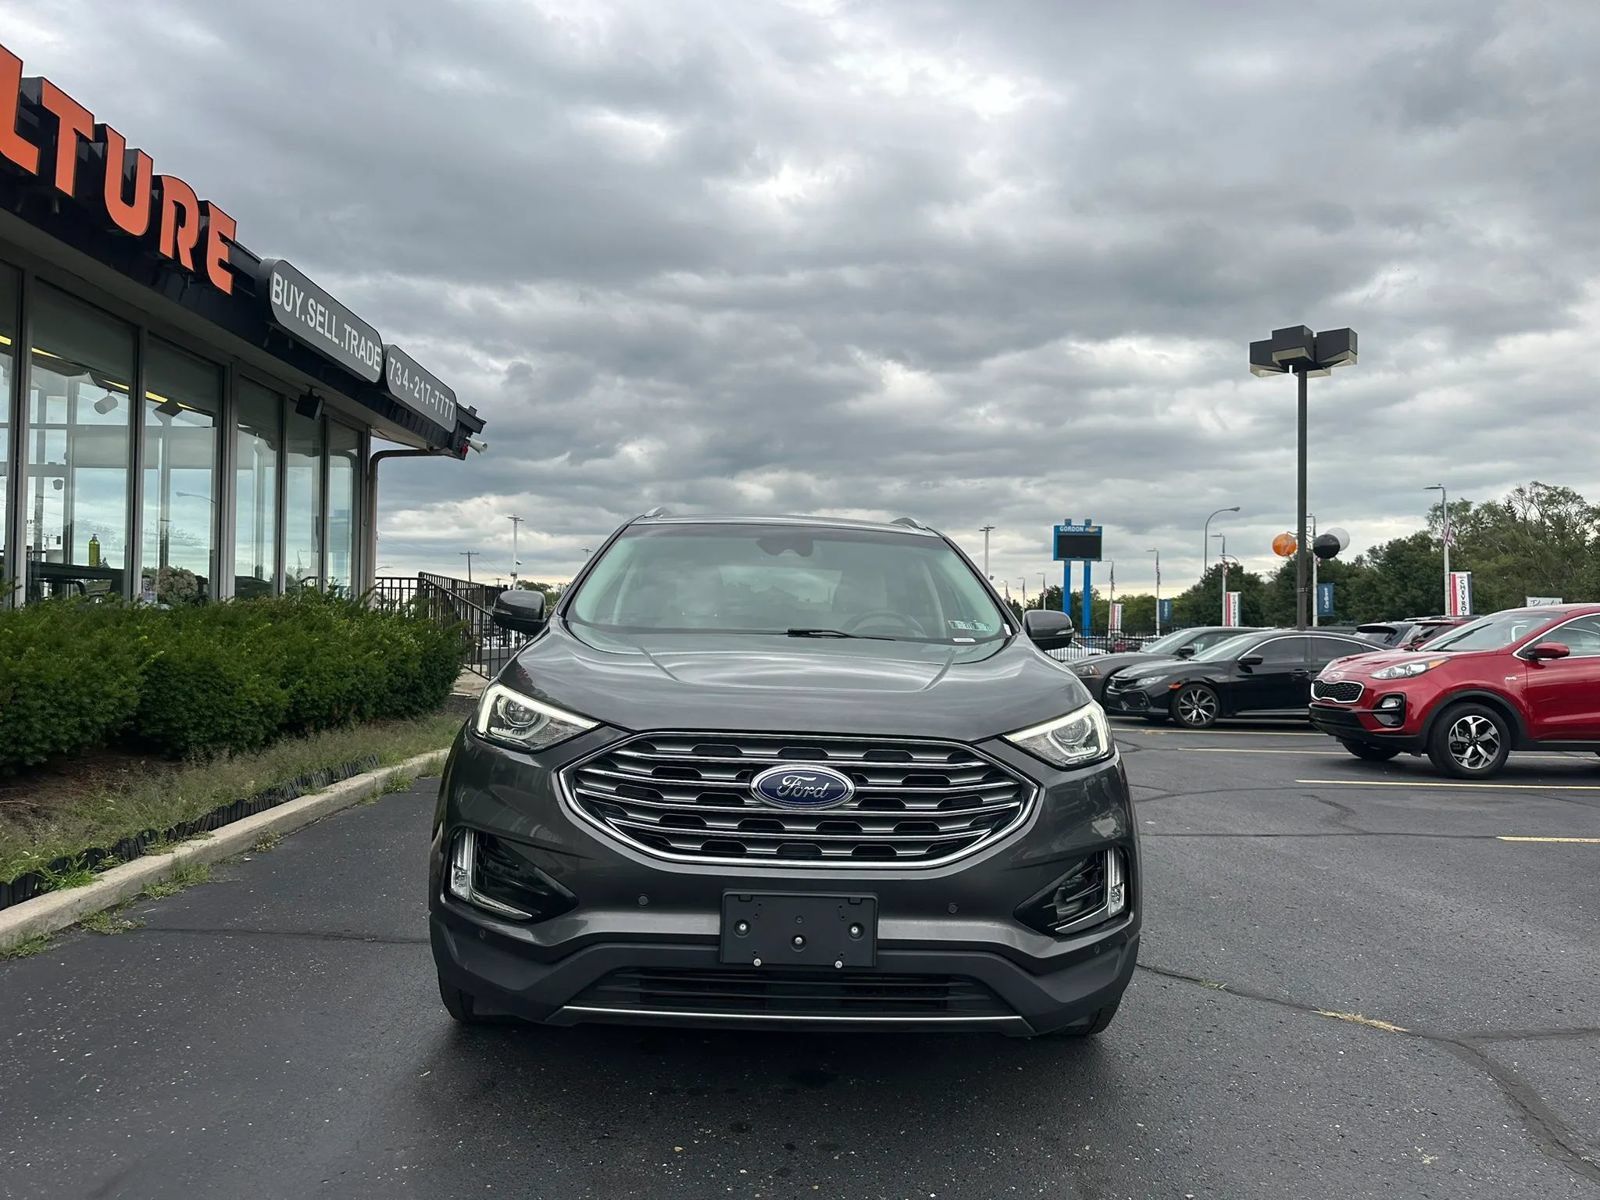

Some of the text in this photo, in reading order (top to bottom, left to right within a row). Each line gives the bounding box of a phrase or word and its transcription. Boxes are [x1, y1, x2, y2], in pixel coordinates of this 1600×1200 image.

[0, 44, 237, 296] LTURE
[389, 356, 455, 421] 734-217-7777
[776, 775, 830, 798] Ford
